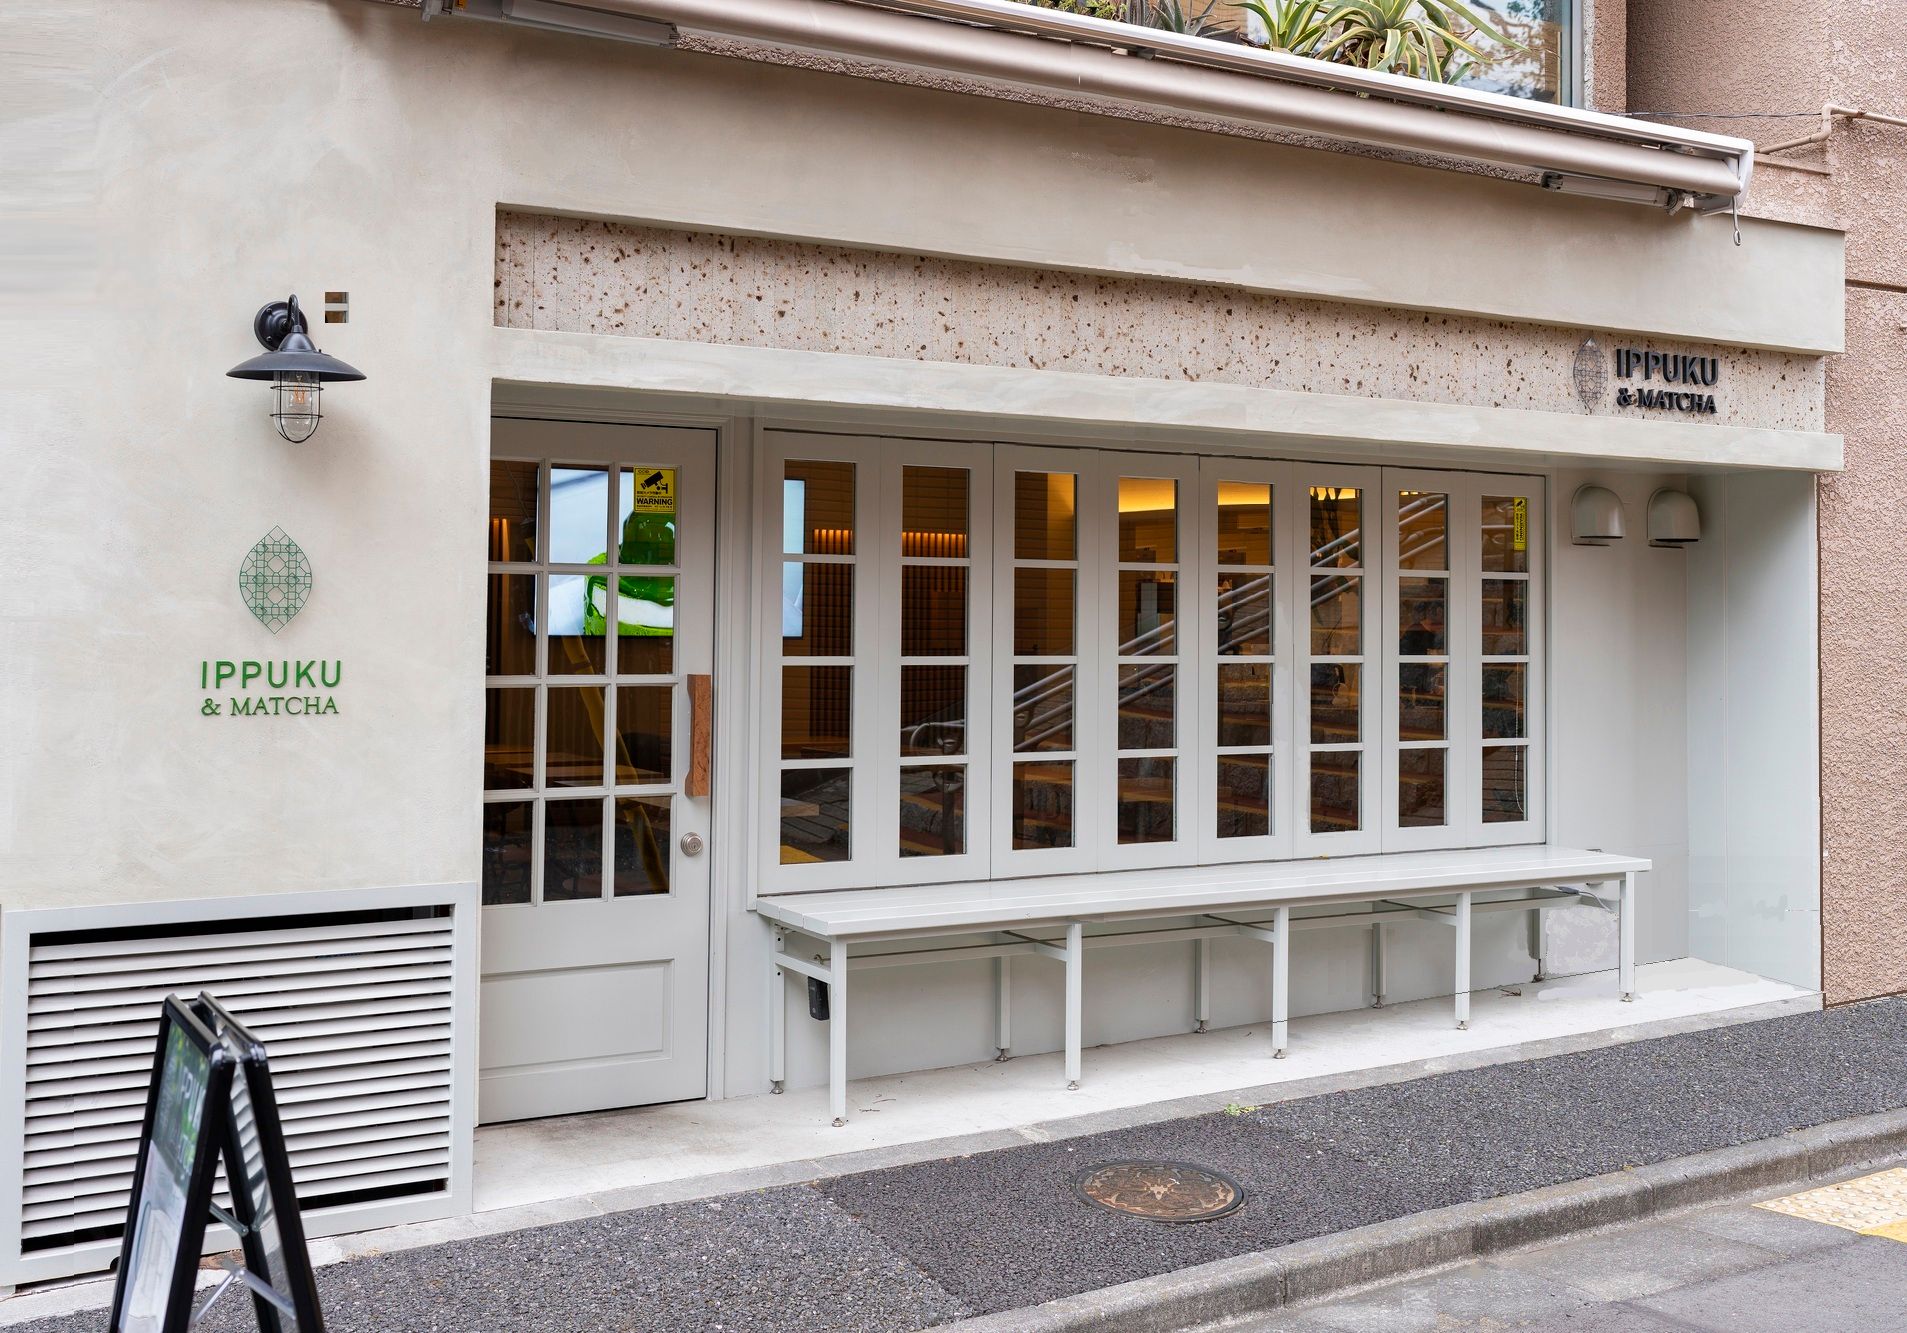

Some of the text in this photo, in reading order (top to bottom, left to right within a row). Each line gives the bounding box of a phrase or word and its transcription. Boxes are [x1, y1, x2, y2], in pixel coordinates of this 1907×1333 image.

[1616, 348, 1719, 386] IPPUKU
[1616, 387, 1718, 414] & MATCHA
[201, 660, 341, 689] IPPUKU
[201, 695, 339, 716] & MATCHA
